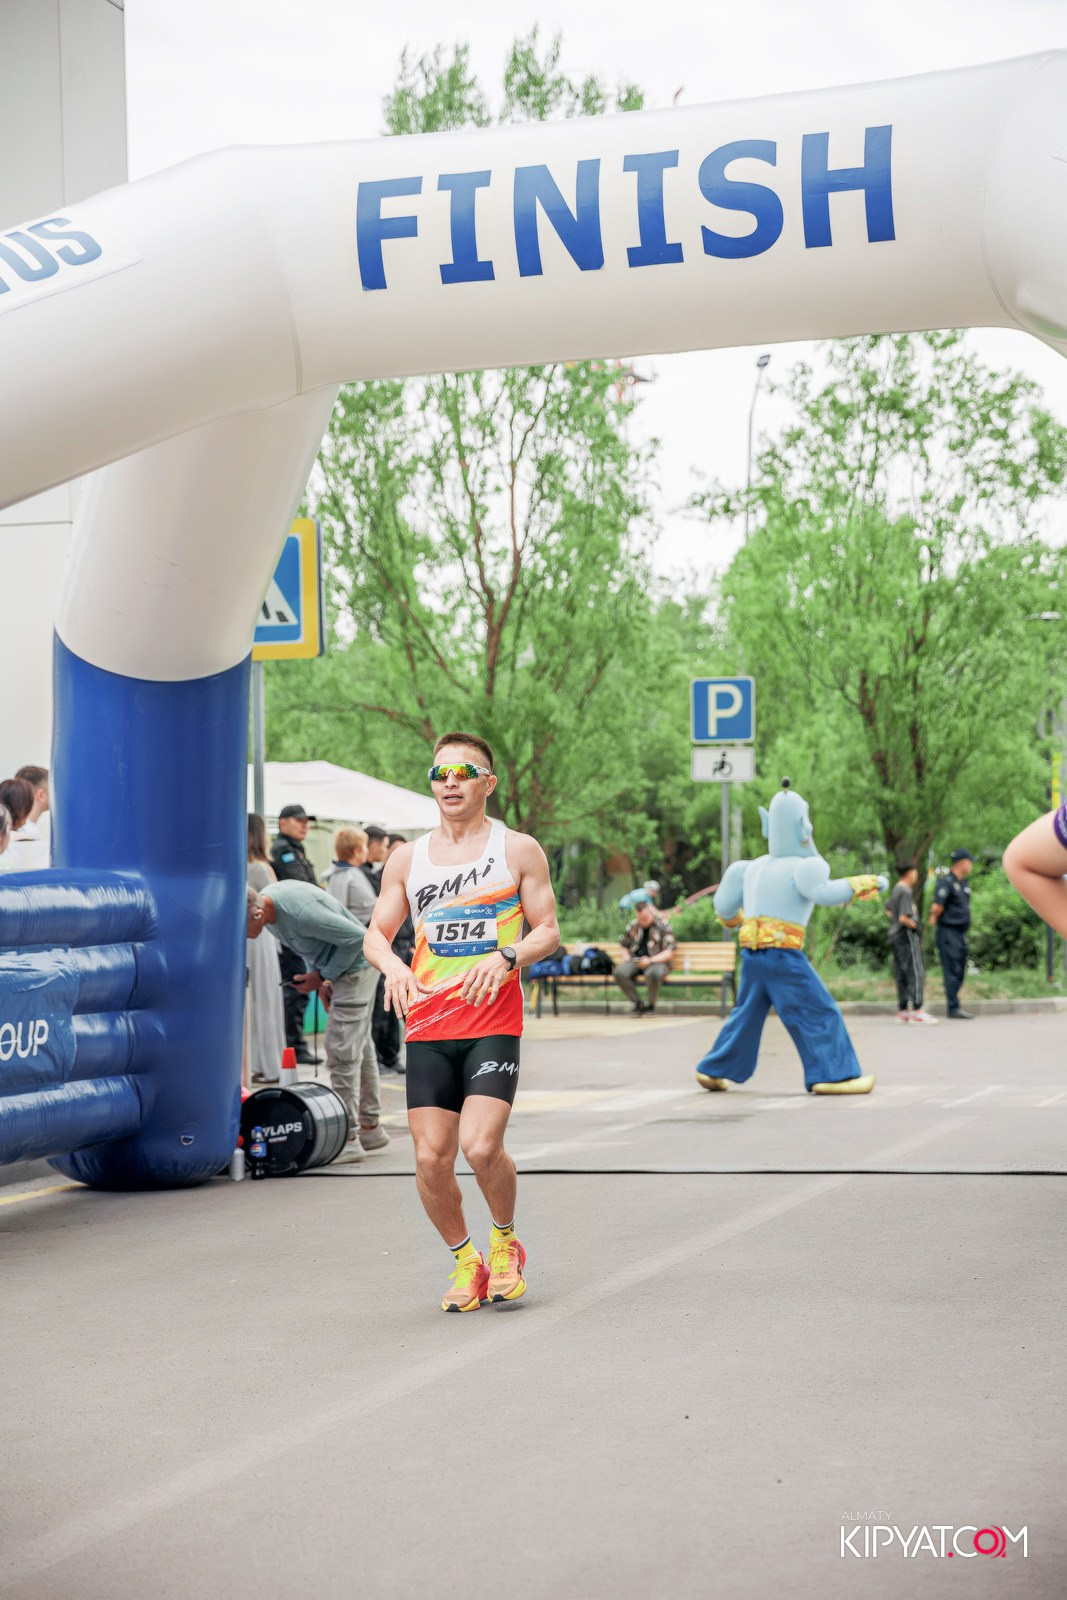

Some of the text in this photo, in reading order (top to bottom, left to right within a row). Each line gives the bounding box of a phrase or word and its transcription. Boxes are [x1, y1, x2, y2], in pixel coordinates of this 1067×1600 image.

[356, 125, 896, 291] FINISH
[0, 217, 103, 295] US
[707, 683, 743, 737] P
[435, 921, 486, 942] 1514
